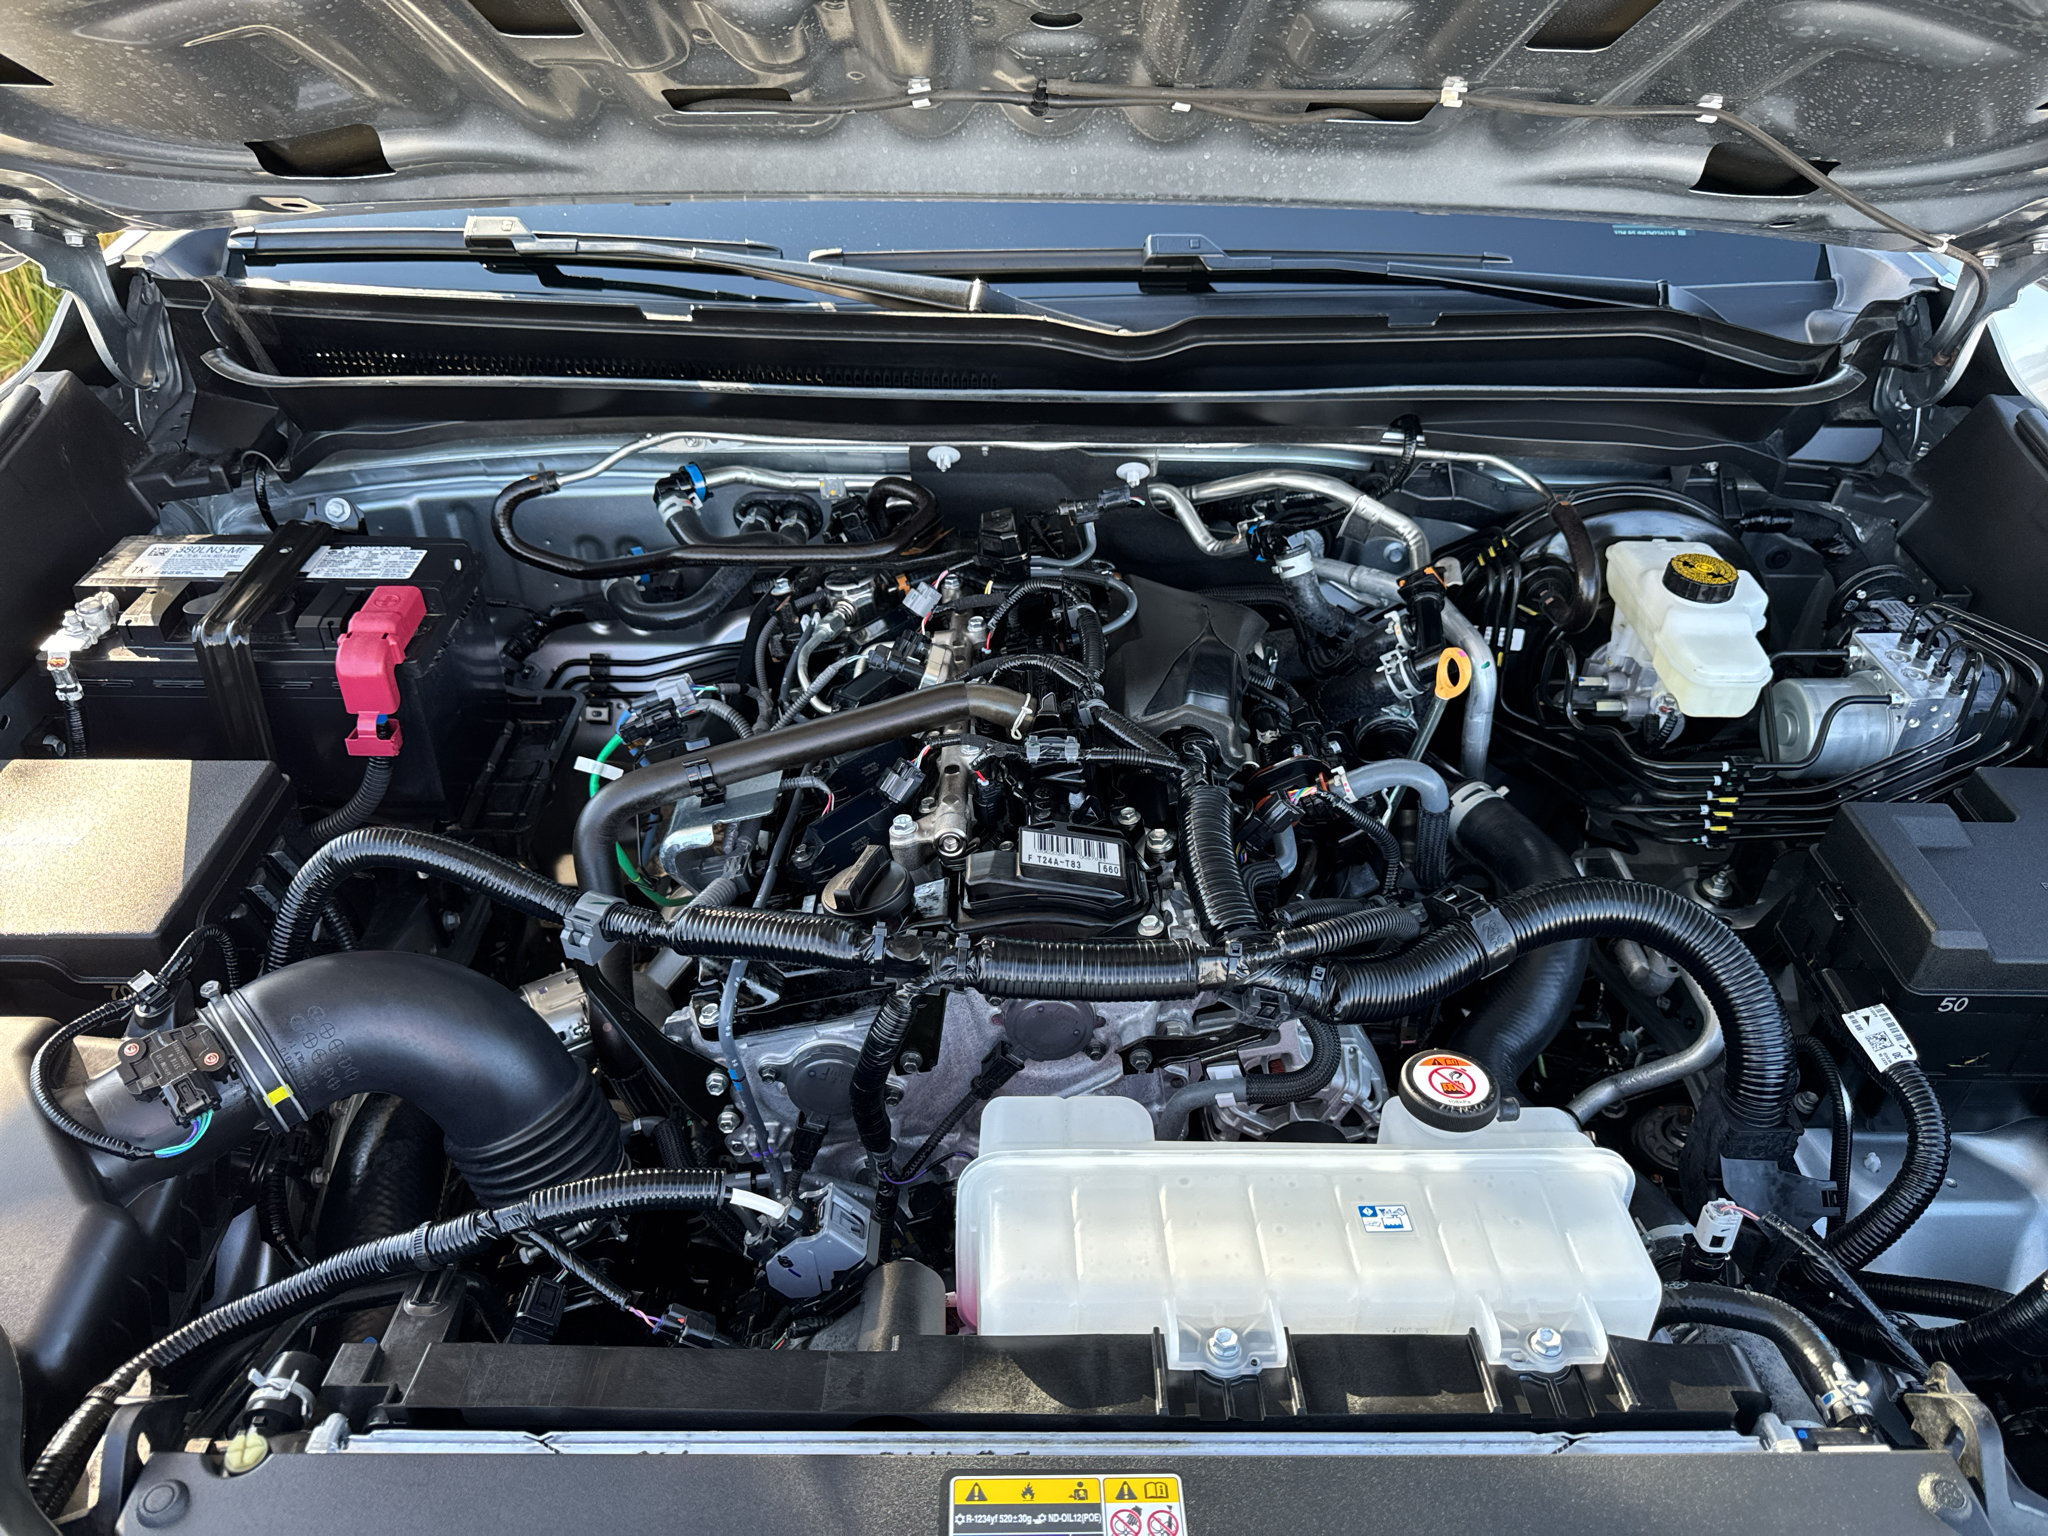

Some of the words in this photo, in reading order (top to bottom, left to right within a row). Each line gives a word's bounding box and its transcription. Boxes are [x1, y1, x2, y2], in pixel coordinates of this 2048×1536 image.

[1037, 855, 1081, 869] T24A-T83
[1103, 865, 1119, 875] 660
[1937, 997, 1968, 1012] 50
[965, 1515, 998, 1525] R-1234yf
[999, 1514, 1032, 1524] 520±30g
[1048, 1513, 1102, 1523] ND-OIL12(POE)
